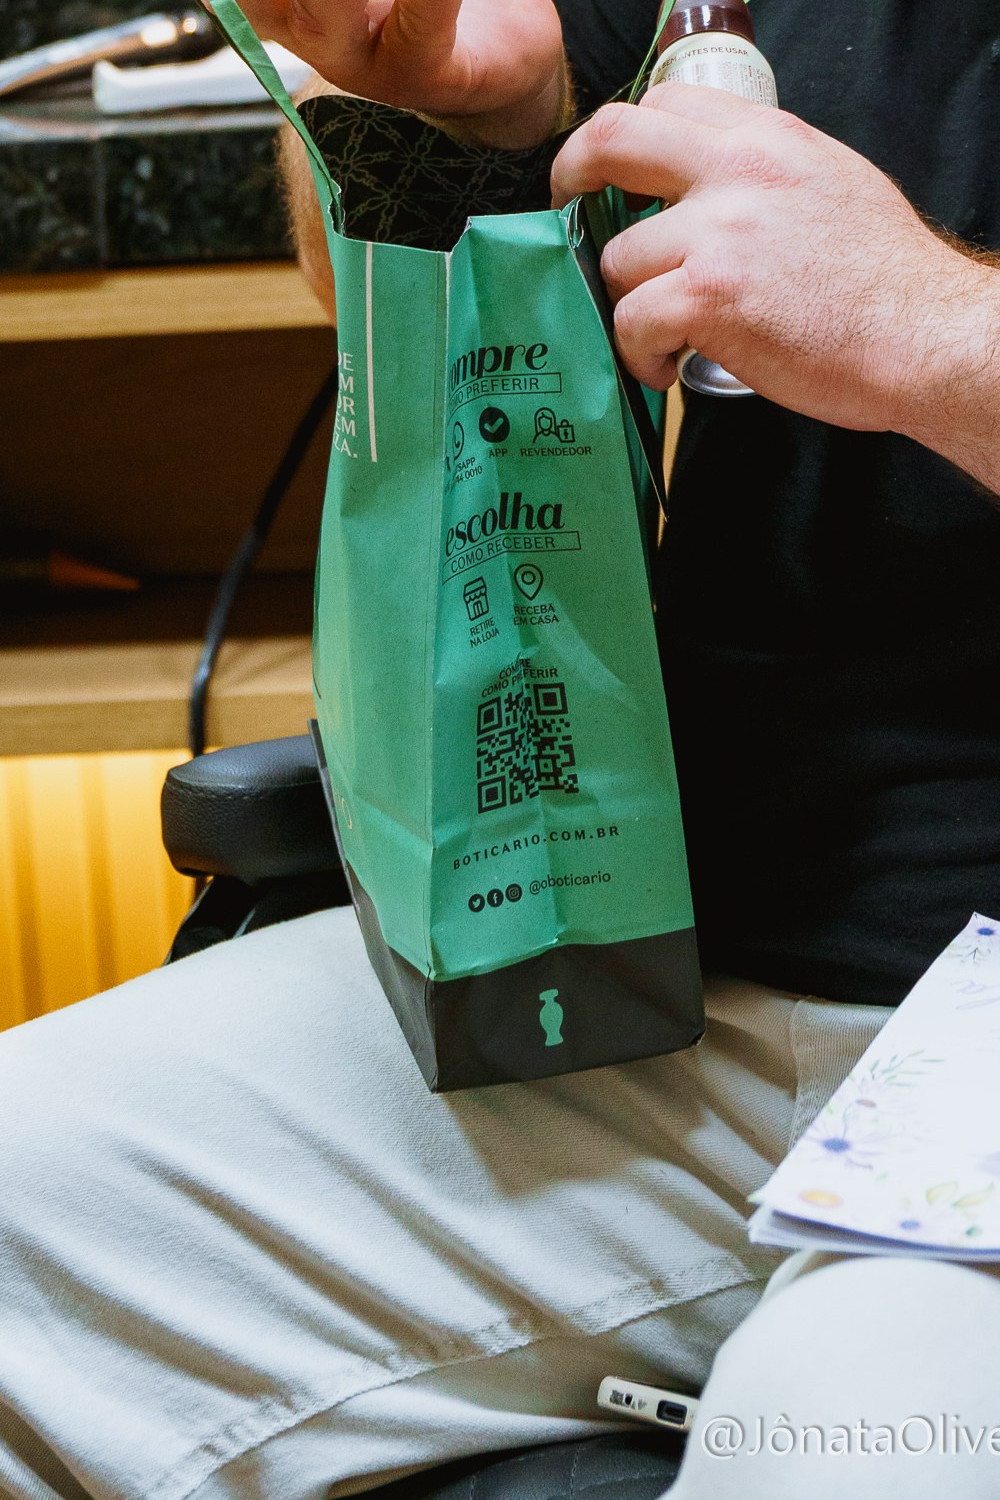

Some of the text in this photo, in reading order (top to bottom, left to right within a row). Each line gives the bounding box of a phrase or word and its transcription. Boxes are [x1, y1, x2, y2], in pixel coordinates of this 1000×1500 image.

[466, 376, 540, 399] PREFERIR
[488, 448, 509, 459] APP
[520, 446, 593, 458] REVENDEDOR
[445, 492, 566, 558] escolha
[451, 536, 556, 574] COMO RECEBER
[513, 604, 556, 615] RECEBA
[513, 614, 560, 626] EM CASA
[469, 616, 496, 637] RETIRE
[469, 627, 500, 648] NA LOJA
[481, 678, 509, 698] COMO
[452, 825, 620, 871] BOTICARIO.COM.BR
[528, 870, 612, 896] @oboticario
